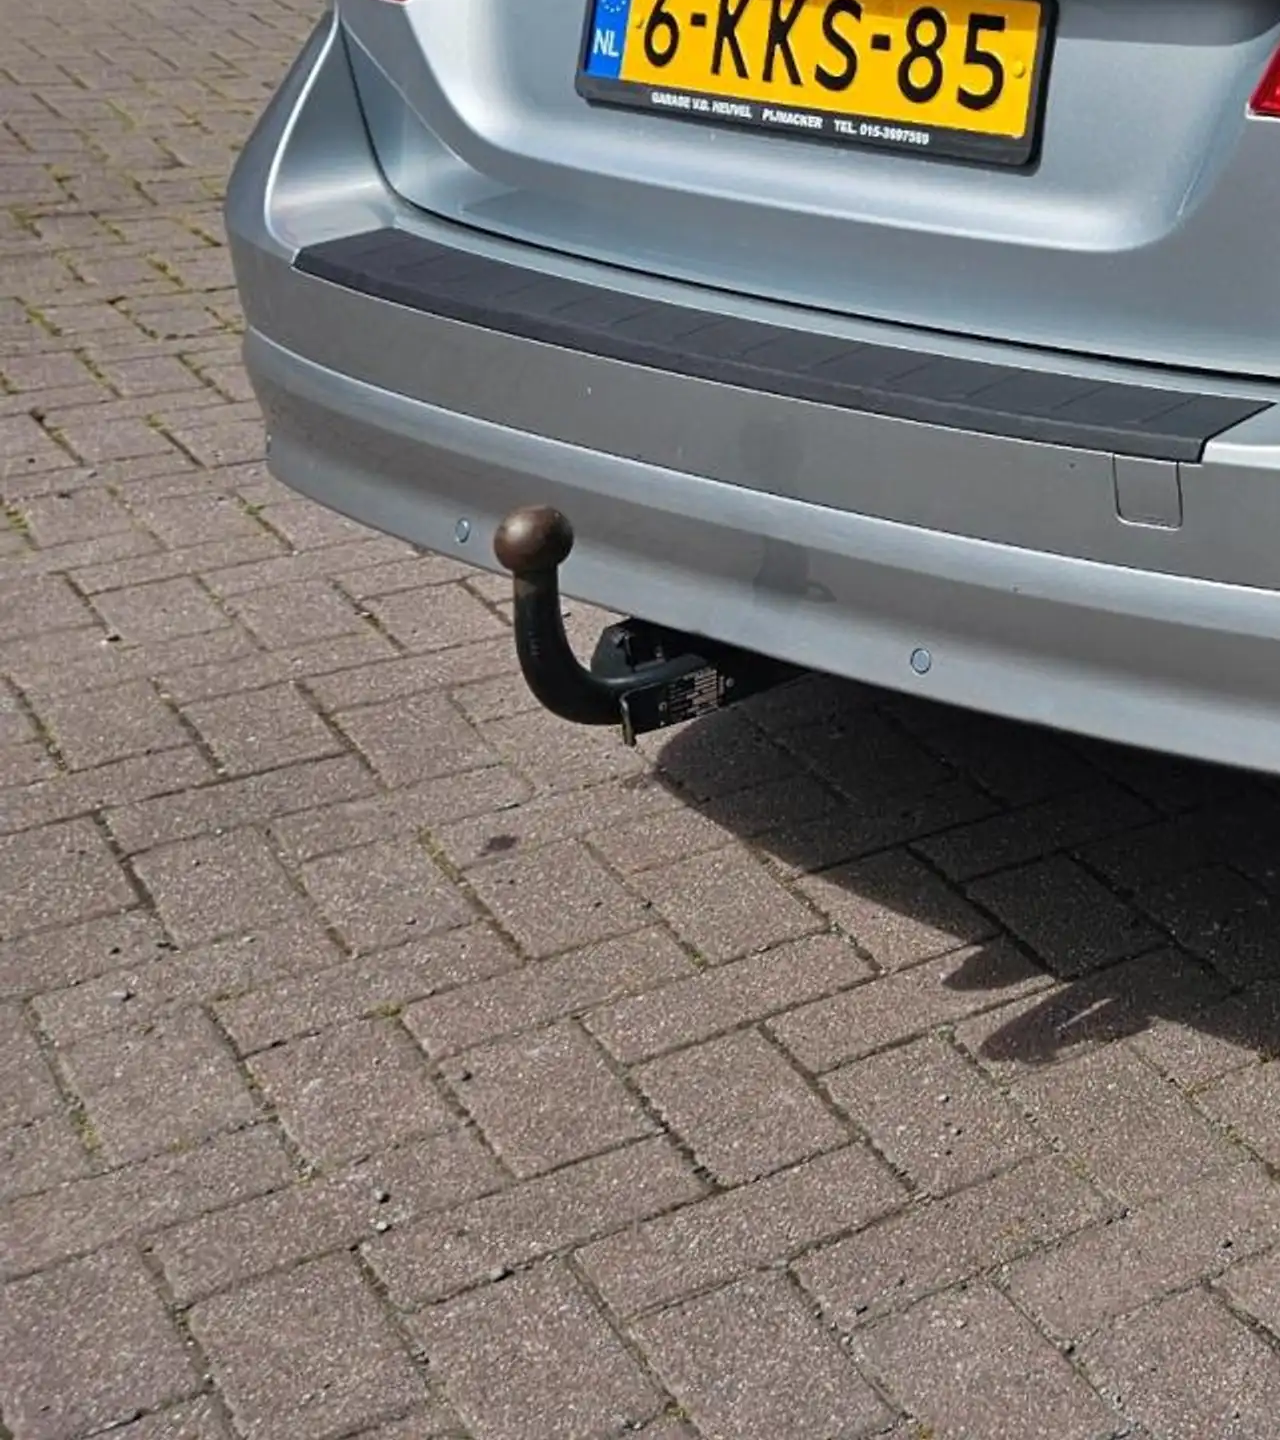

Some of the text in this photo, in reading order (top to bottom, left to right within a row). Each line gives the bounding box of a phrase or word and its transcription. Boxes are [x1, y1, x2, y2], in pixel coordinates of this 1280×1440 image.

[593, 28, 620, 58] NL
[651, 91, 691, 109] GARAGE
[711, 100, 753, 119] HEUVEL
